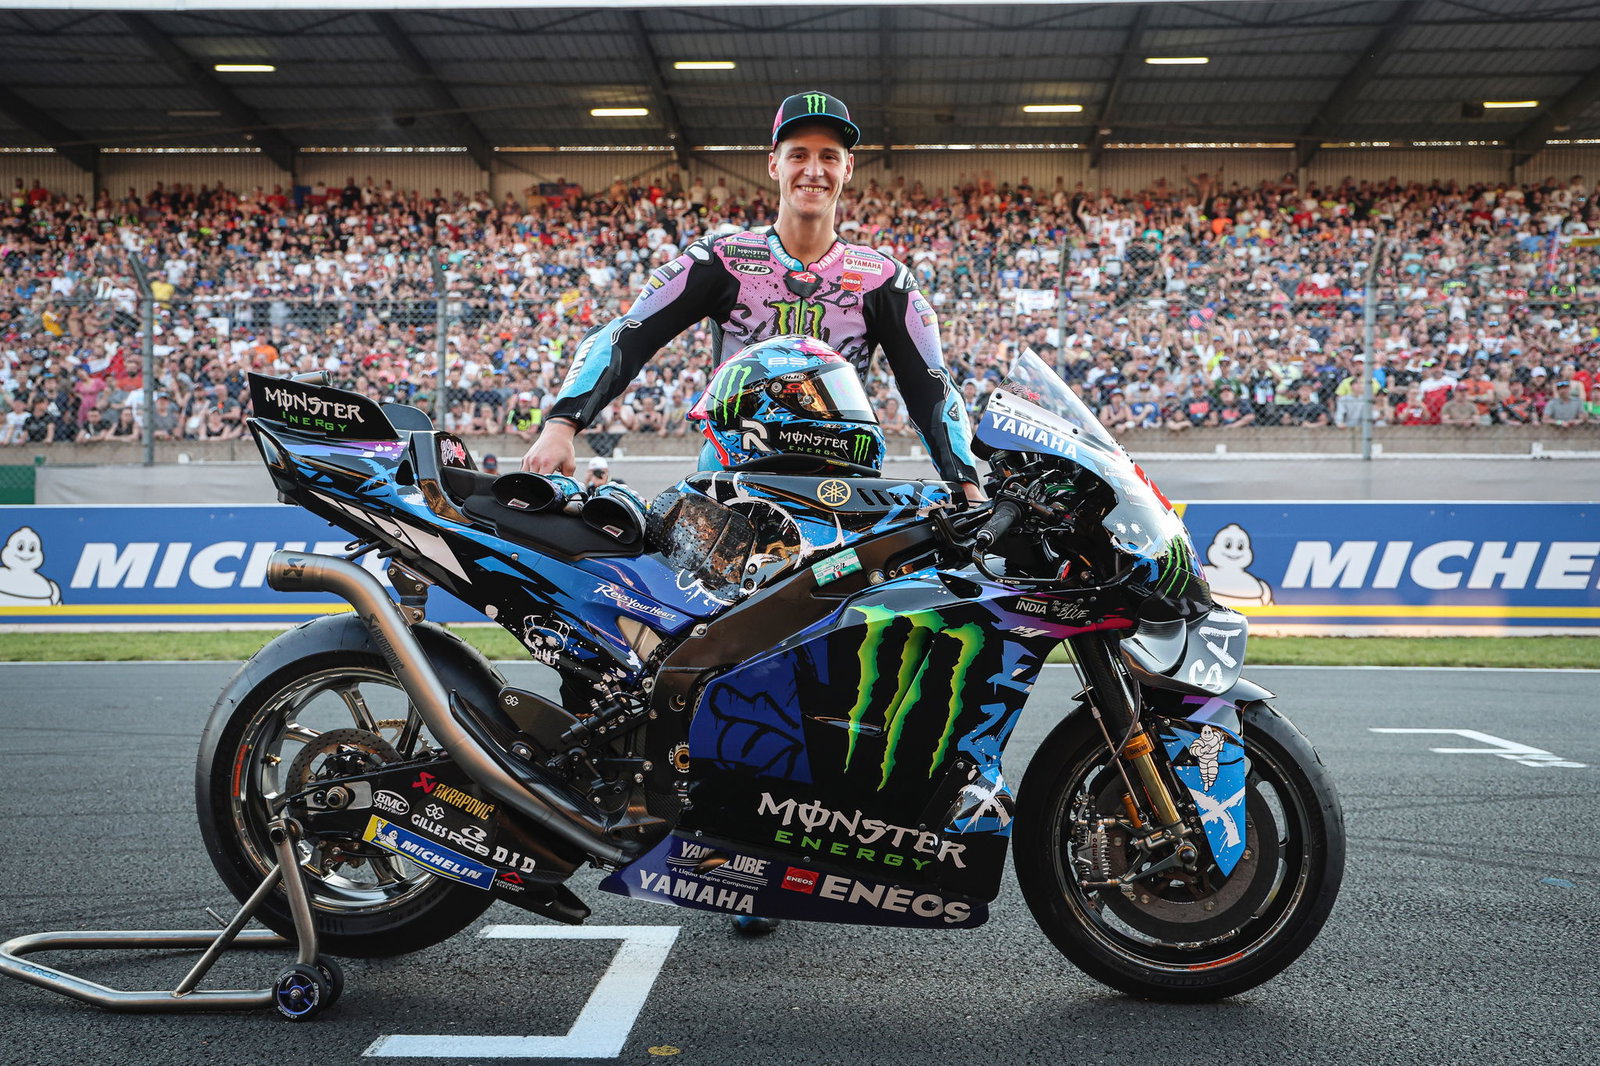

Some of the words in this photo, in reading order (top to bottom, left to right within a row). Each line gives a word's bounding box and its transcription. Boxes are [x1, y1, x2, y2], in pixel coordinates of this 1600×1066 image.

[737, 248, 769, 256] MONSTER
[769, 238, 795, 269] YAMAHA
[817, 243, 845, 270] YAMAHA
[853, 259, 882, 269] YAMAHA
[738, 264, 769, 273] HJC
[264, 386, 365, 423] MONSTER
[779, 430, 849, 450] MONSTER
[991, 413, 1079, 459] YAMAHA
[1281, 540, 1600, 590] MICHE
[1015, 600, 1047, 615] INDIA
[1057, 606, 1090, 620] BLUE
[376, 792, 406, 811] BMC
[411, 813, 448, 838] GILLES
[757, 791, 967, 869] MONSTER
[447, 830, 490, 857] RCB
[774, 829, 932, 871] ENERGY
[400, 840, 483, 880] MICHELIN
[681, 841, 765, 876] YAMLUBE
[639, 869, 754, 914] YAMAHA
[722, 879, 759, 891] Component
[786, 875, 814, 886] ENEOS
[819, 874, 971, 924] ENEOS
